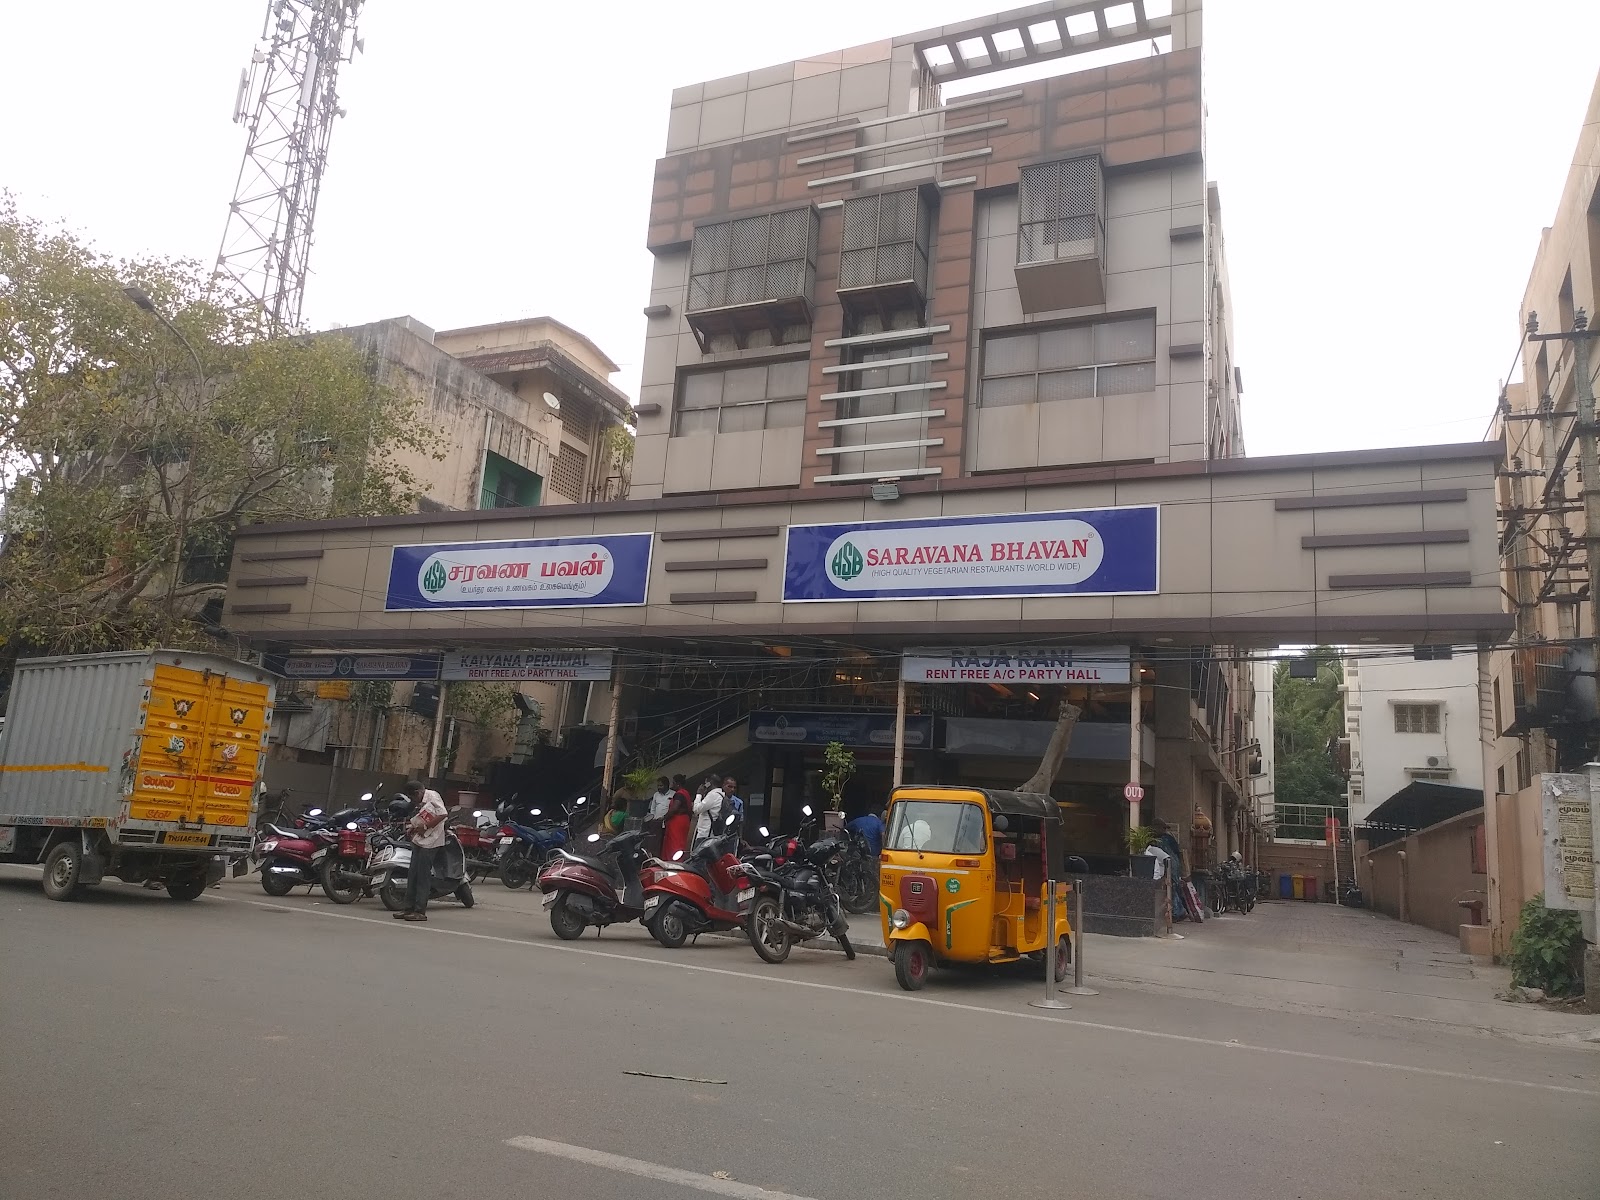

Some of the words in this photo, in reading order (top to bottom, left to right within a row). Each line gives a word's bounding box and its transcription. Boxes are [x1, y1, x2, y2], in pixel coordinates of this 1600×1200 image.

[866, 544, 983, 567] SARAVANA
[991, 538, 1088, 561] BHAVAN
[448, 562, 531, 583] சரவண
[540, 552, 606, 577] பவன்
[871, 568, 892, 578] (HIGH
[893, 567, 922, 577] QUALITY
[923, 565, 969, 575] VEGETARIAN
[970, 563, 1025, 574] RESTAURANTS
[1026, 562, 1056, 572] WORLD
[1056, 561, 1081, 573] WIDE)
[460, 654, 521, 668] KALYANA
[525, 653, 590, 667] PERUMAL
[951, 648, 1010, 668] RAJA
[1017, 648, 1073, 668] RANI
[468, 669, 489, 678] RENT
[491, 669, 510, 678] FREE
[511, 669, 526, 678] A/C
[527, 669, 555, 678] PARTY
[556, 668, 579, 678] HALL
[926, 669, 957, 679] RENT
[960, 669, 990, 679] FREE
[993, 669, 1016, 680] A/C
[1019, 669, 1063, 680] PARTY
[1066, 669, 1101, 680] HALL
[143, 776, 176, 791] SOUND
[214, 783, 242, 796] HORN
[1125, 786, 1143, 798] OUT
